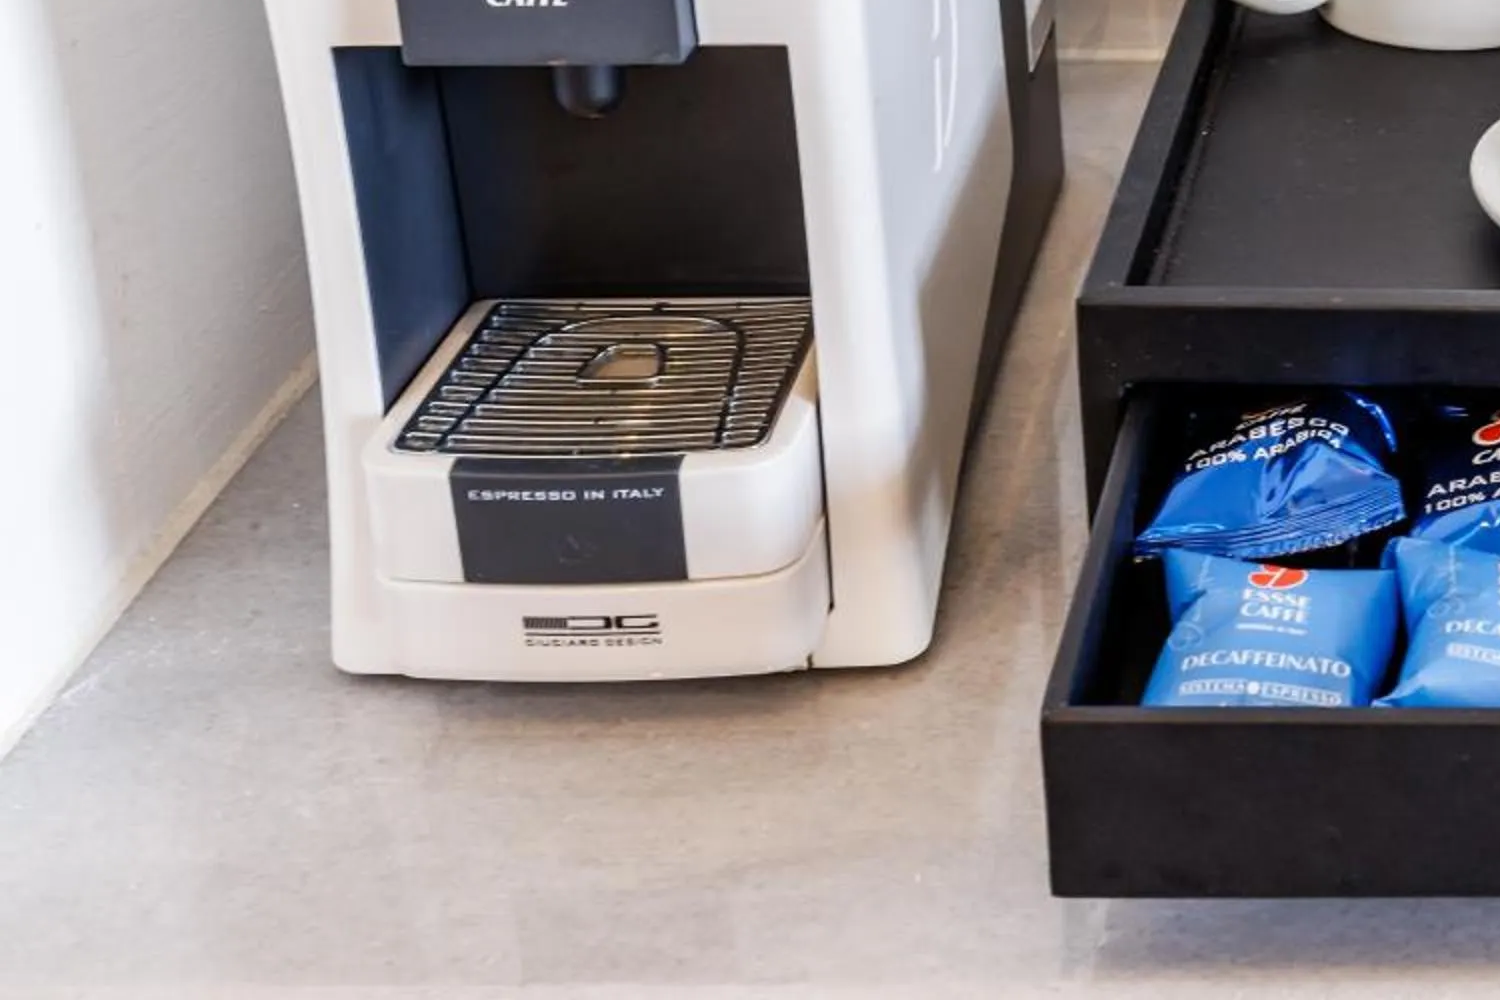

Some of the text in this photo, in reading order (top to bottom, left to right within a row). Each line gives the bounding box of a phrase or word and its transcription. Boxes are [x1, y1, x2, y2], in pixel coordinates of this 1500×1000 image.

[1185, 428, 1342, 472] 100% ARABICA
[1187, 417, 1350, 461] ARABESCO
[467, 487, 665, 501] ESPRESSO IN ITALY
[1424, 490, 1486, 514] 100%
[1181, 649, 1352, 678] DECAFFEINATO
